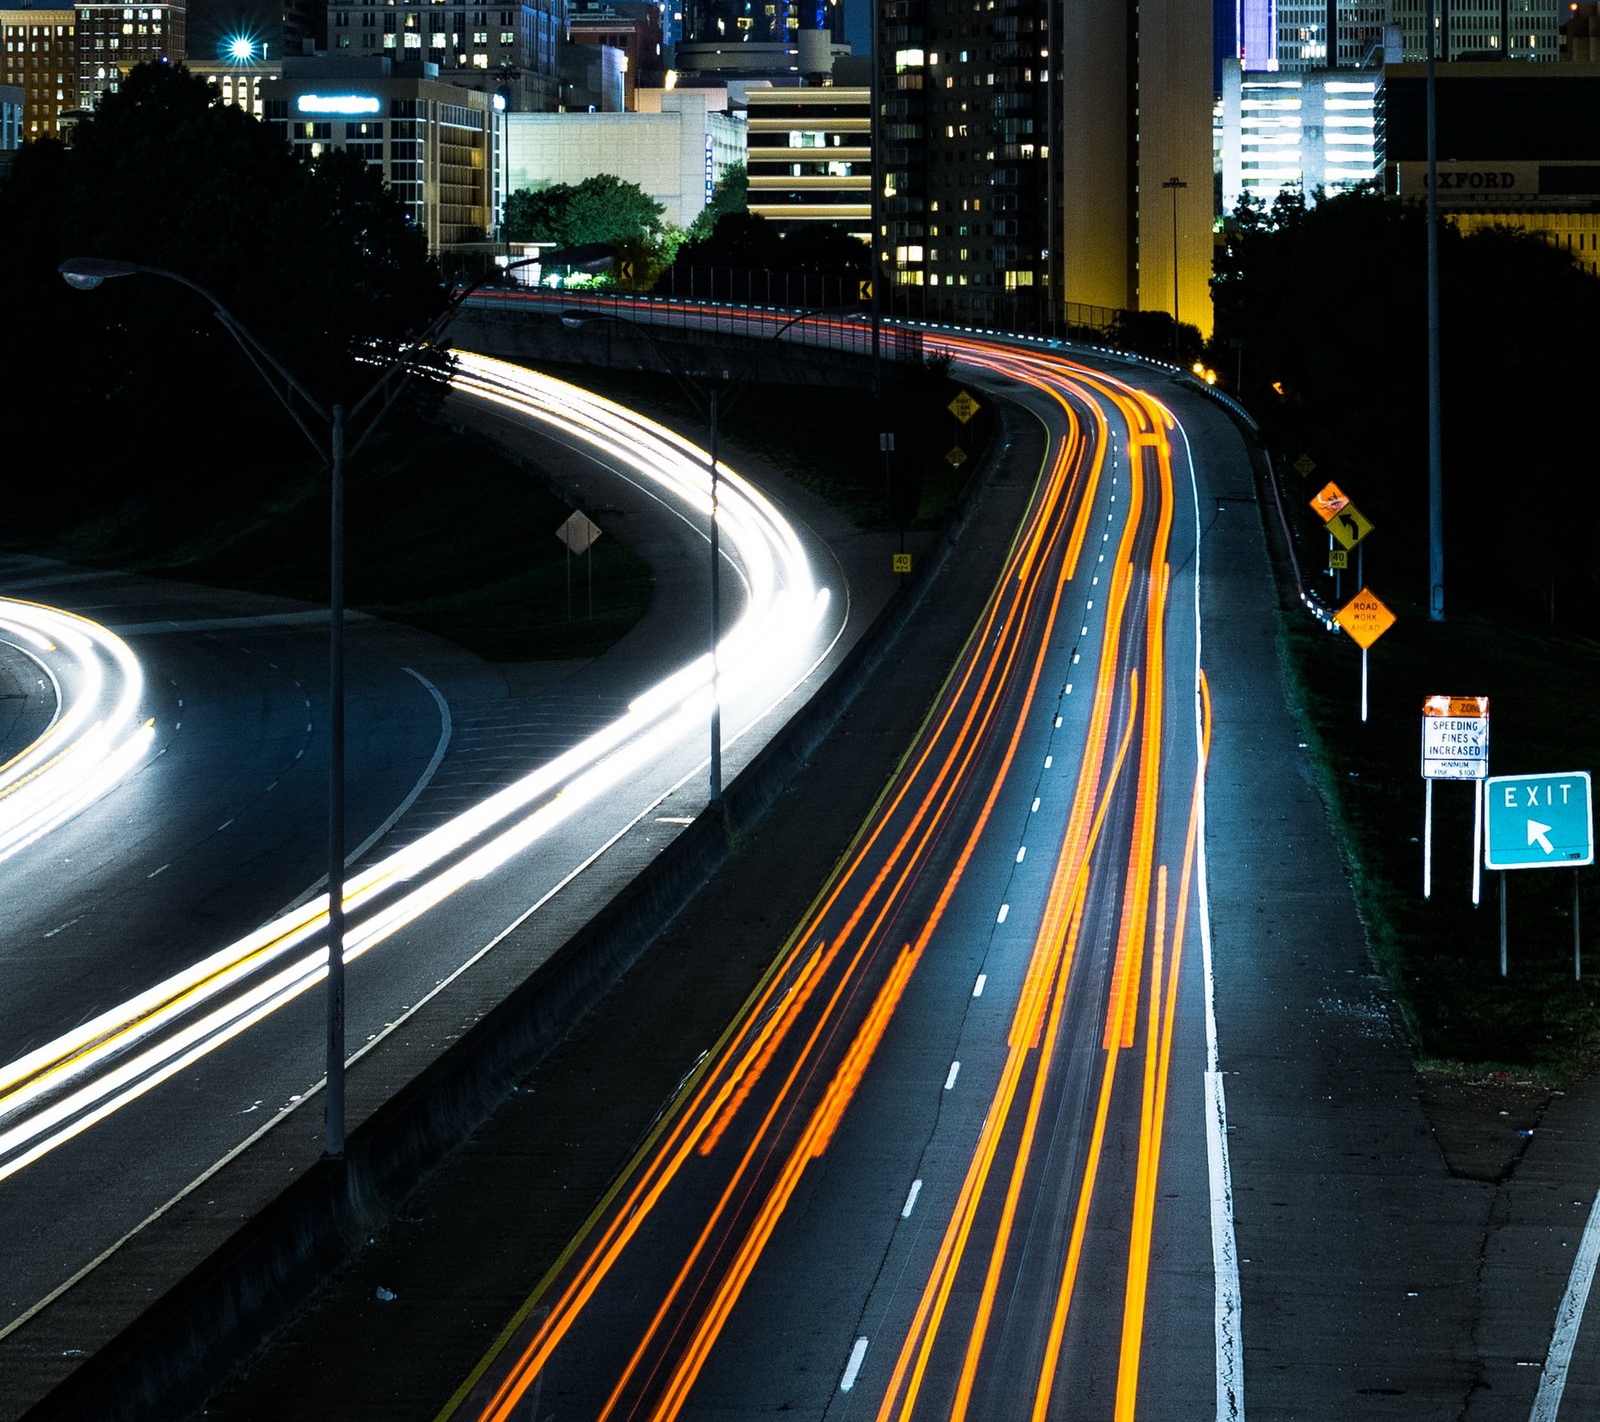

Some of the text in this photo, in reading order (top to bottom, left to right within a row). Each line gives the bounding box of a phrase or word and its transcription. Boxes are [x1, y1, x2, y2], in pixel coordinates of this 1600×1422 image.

[1423, 172, 1515, 188] XFORD
[897, 556, 908, 565] 40
[1333, 552, 1344, 562] 40
[1353, 602, 1378, 611] ROAD
[1353, 613, 1377, 621] WORK
[1351, 624, 1380, 632] AHEAD
[1433, 721, 1478, 731] SPEEDING
[1442, 733, 1469, 743] FINES
[1429, 746, 1481, 756] INCREASED
[1505, 784, 1571, 807] EXIT
